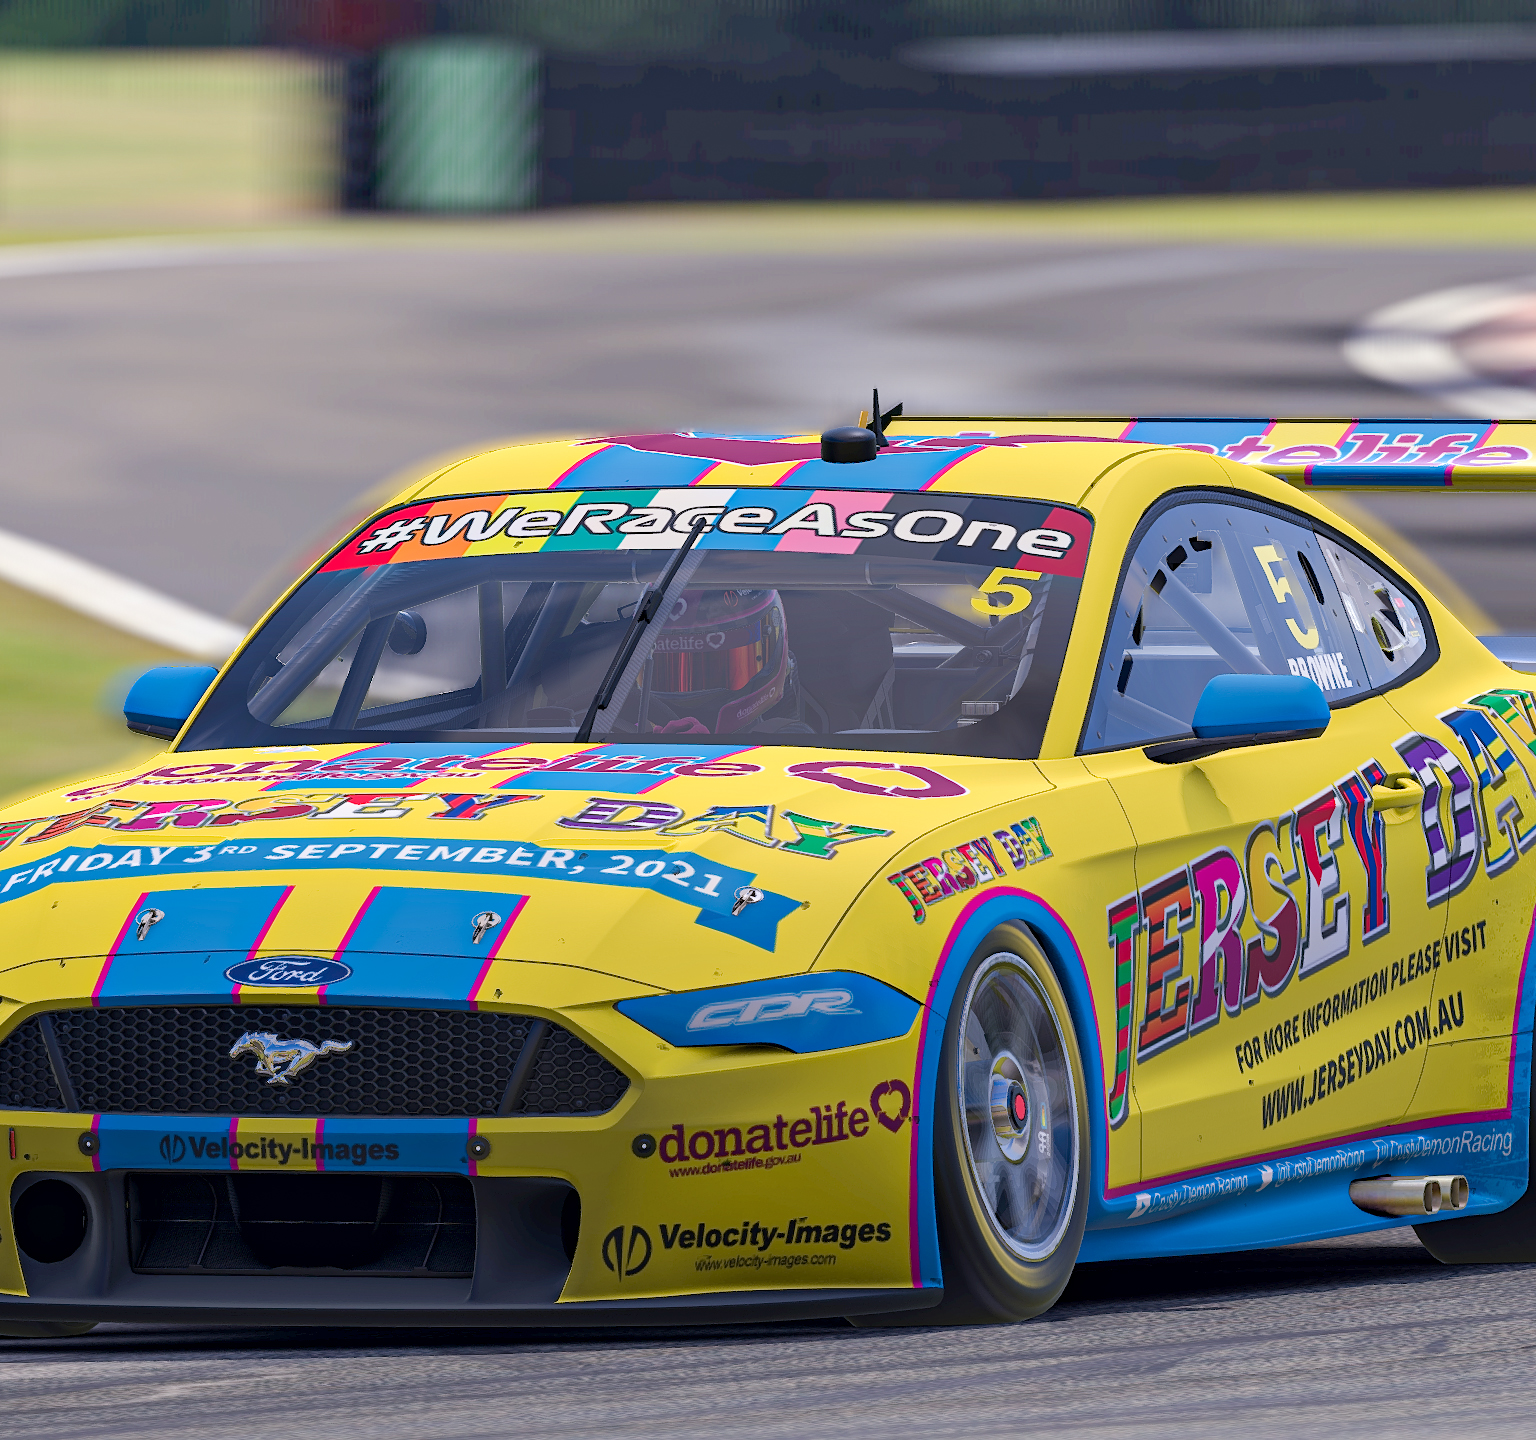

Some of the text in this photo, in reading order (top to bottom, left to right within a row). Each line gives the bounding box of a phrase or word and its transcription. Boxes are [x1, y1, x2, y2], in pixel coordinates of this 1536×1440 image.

[1173, 433, 1532, 466] telife
[357, 500, 1075, 558] #WeRaceAsOne
[970, 567, 1043, 616] 5
[1253, 544, 1319, 649] 5
[555, 797, 894, 860] DAY
[0, 847, 178, 894] FRIDAY
[265, 843, 588, 874] SEPTEMBER,
[600, 855, 721, 898] 2021
[886, 816, 1054, 925] JERSEY DAY
[248, 960, 328, 982] Ford
[1106, 757, 1391, 1131] JERSEY
[1235, 920, 1486, 1074] FOR MORE INFORMATION PLEASE VISIT
[1262, 991, 1464, 1130] WWW.JERSEYDAY.COM.AU
[188, 1137, 399, 1166] Velocity-Images
[659, 1101, 869, 1163] donatelife
[669, 1152, 801, 1178] www.donatelife.gov.au
[659, 1217, 891, 1251] Velocity-Images
